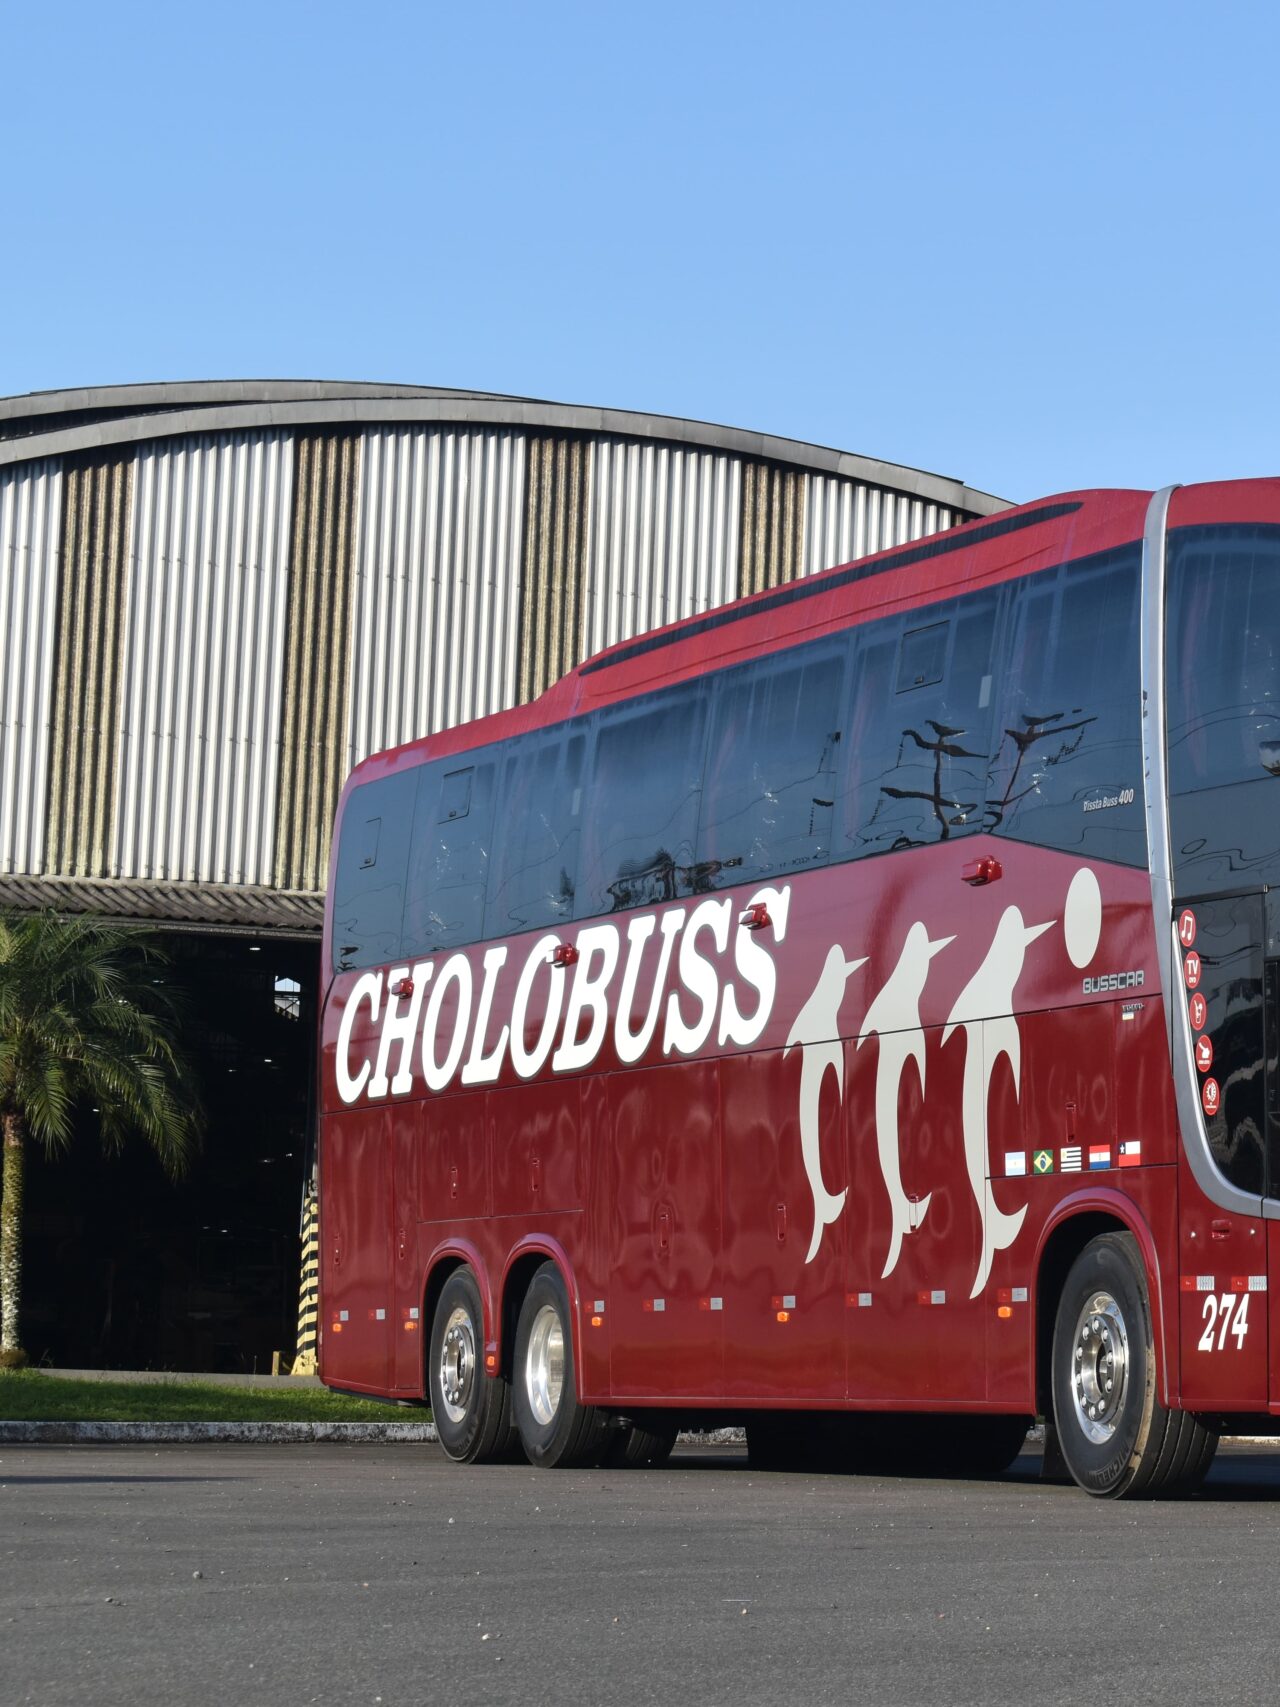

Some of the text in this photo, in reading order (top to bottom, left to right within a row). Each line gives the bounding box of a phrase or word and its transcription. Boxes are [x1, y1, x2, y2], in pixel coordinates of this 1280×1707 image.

[1102, 796, 1118, 808] Buss
[1118, 788, 1134, 805] 400
[1186, 959, 1199, 975] TV
[1082, 969, 1145, 994] BUSSCAR
[334, 885, 792, 1104] CHOLOBUSS
[1197, 1292, 1250, 1352] 274
